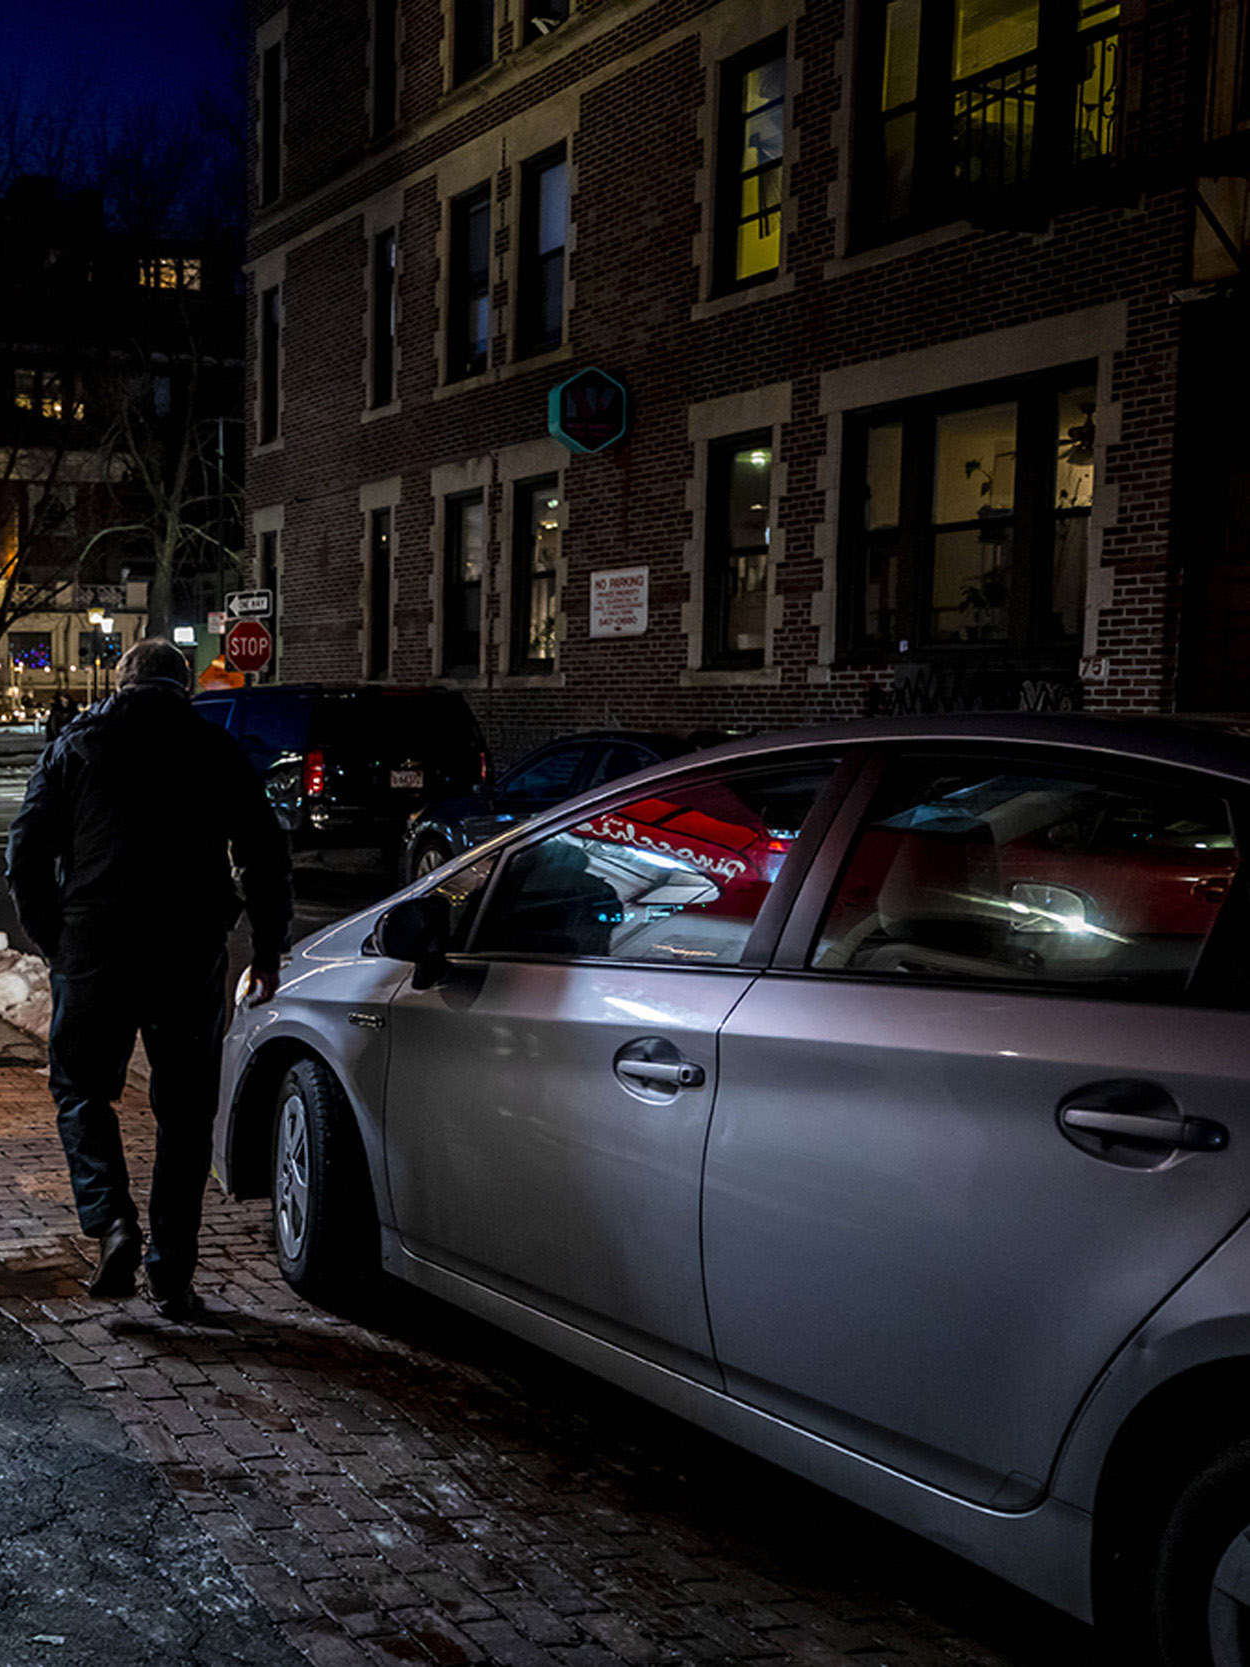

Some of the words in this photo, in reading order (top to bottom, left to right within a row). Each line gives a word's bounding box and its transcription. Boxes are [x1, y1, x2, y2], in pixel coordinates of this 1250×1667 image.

[595, 579, 607, 590] NO
[610, 575, 644, 588] PARKING
[230, 636, 269, 656] STOP
[1081, 658, 1102, 676] 75
